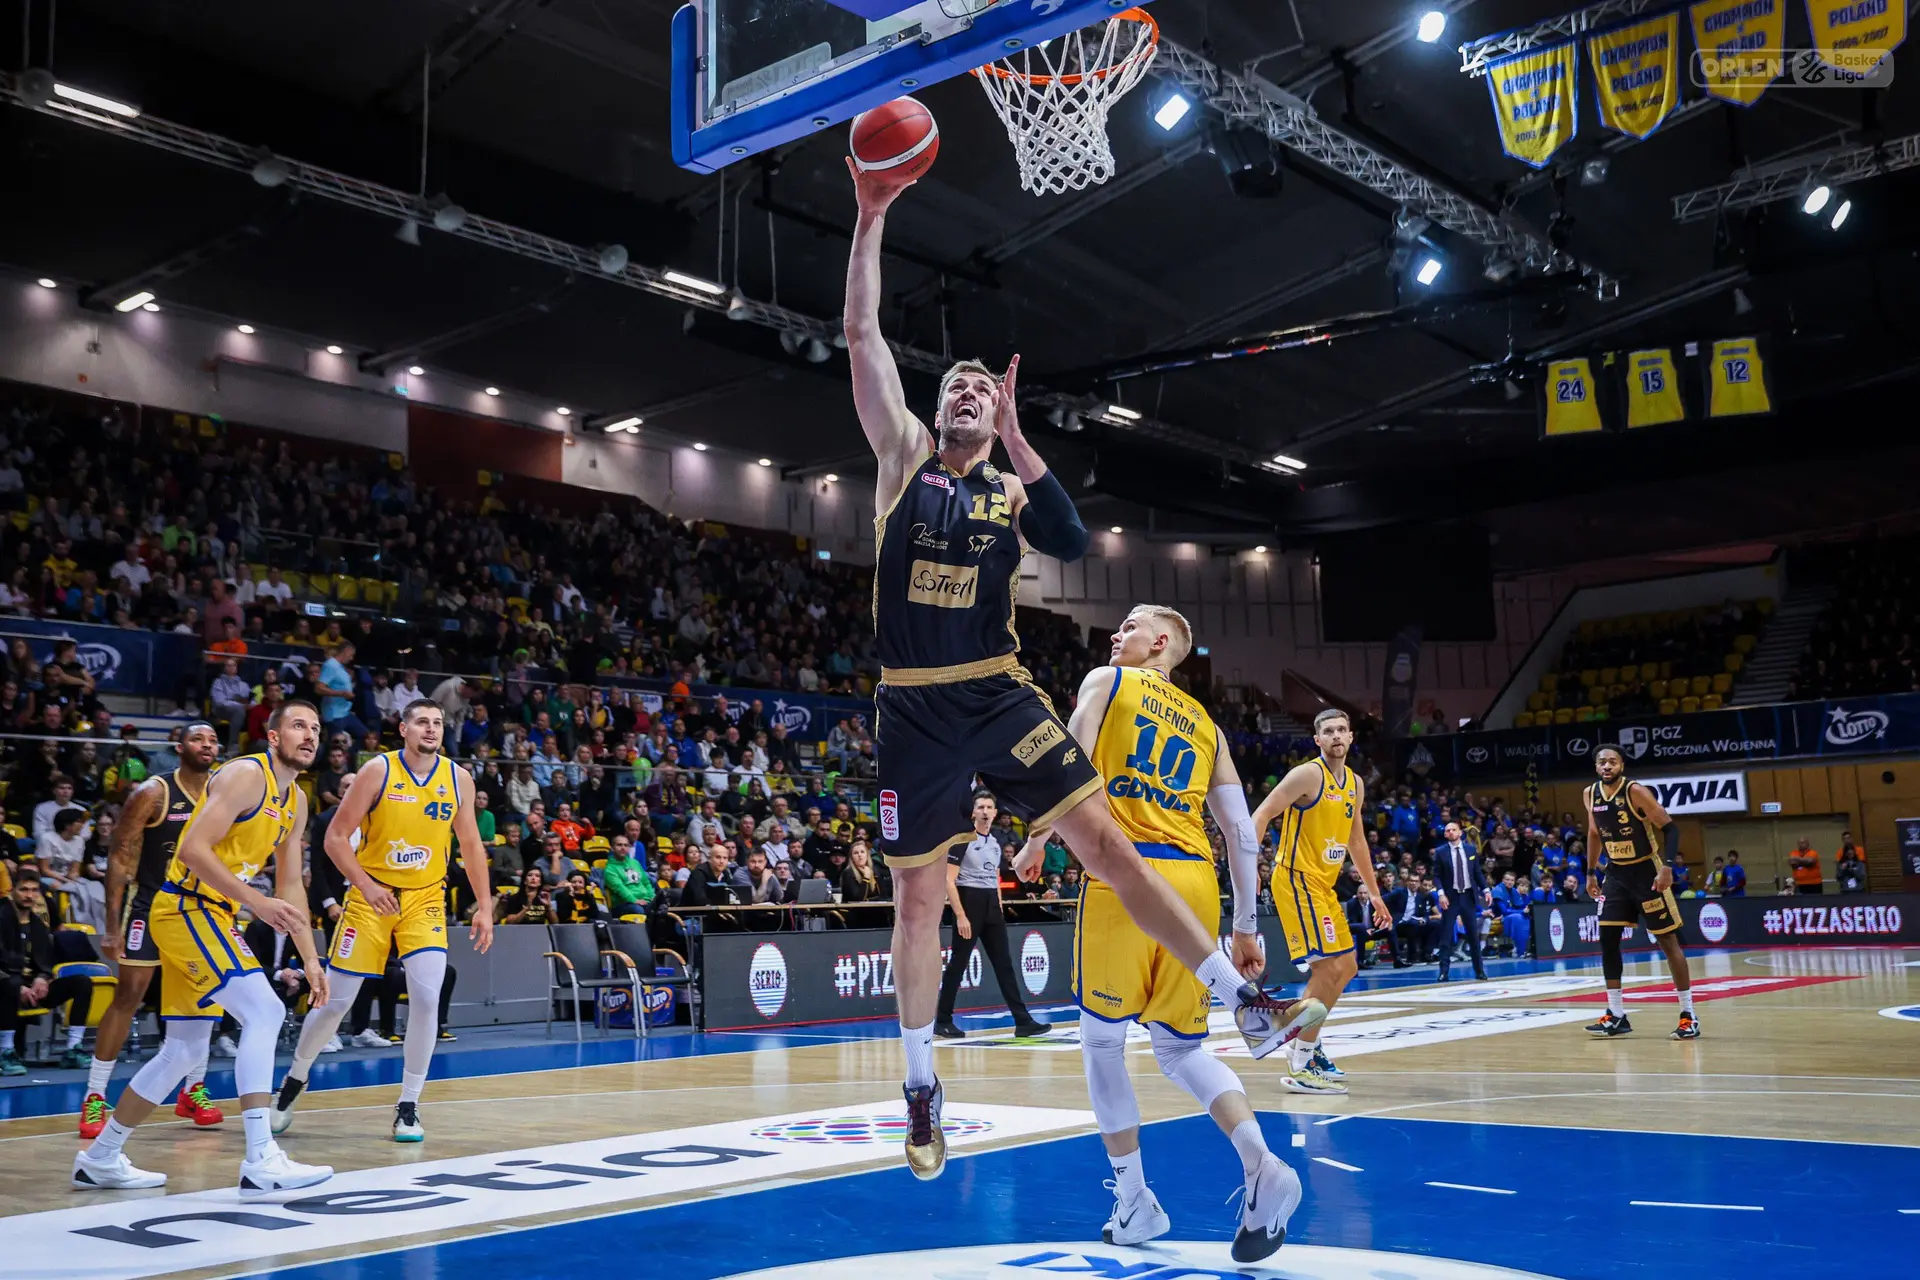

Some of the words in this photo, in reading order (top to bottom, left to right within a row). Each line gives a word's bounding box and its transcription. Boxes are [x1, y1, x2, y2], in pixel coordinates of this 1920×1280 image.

[1704, 2, 1774, 33] CHAMPION
[1829, 0, 1888, 28] POLAND
[1600, 33, 1668, 66] CHAMPION
[1716, 31, 1766, 59] POLAND
[1503, 62, 1566, 95] CHAMPION
[1612, 64, 1663, 93] POLAND
[1513, 94, 1561, 122] POLAND
[1640, 369, 1664, 394] 15
[1724, 359, 1749, 384] 12
[1557, 379, 1585, 403] 24
[924, 475, 945, 486] ORLEN
[968, 493, 1011, 527] 12
[937, 574, 975, 599] Trefl
[1141, 678, 1184, 708] netia
[1142, 694, 1196, 738] KOLENDA
[1836, 716, 1877, 738] LOTTO
[1030, 724, 1058, 749] Trefl
[1652, 725, 1683, 740] PGZ
[1125, 713, 1196, 791] 10
[1504, 744, 1550, 757] WALDER
[1647, 778, 1739, 808] YNIA
[424, 801, 454, 821] 45
[1617, 810, 1629, 824] 3
[397, 851, 424, 863] LOTTO
[1763, 905, 1901, 935] #PIZZASERIO
[756, 970, 781, 989] SERIO
[69, 1144, 780, 1249] netia
